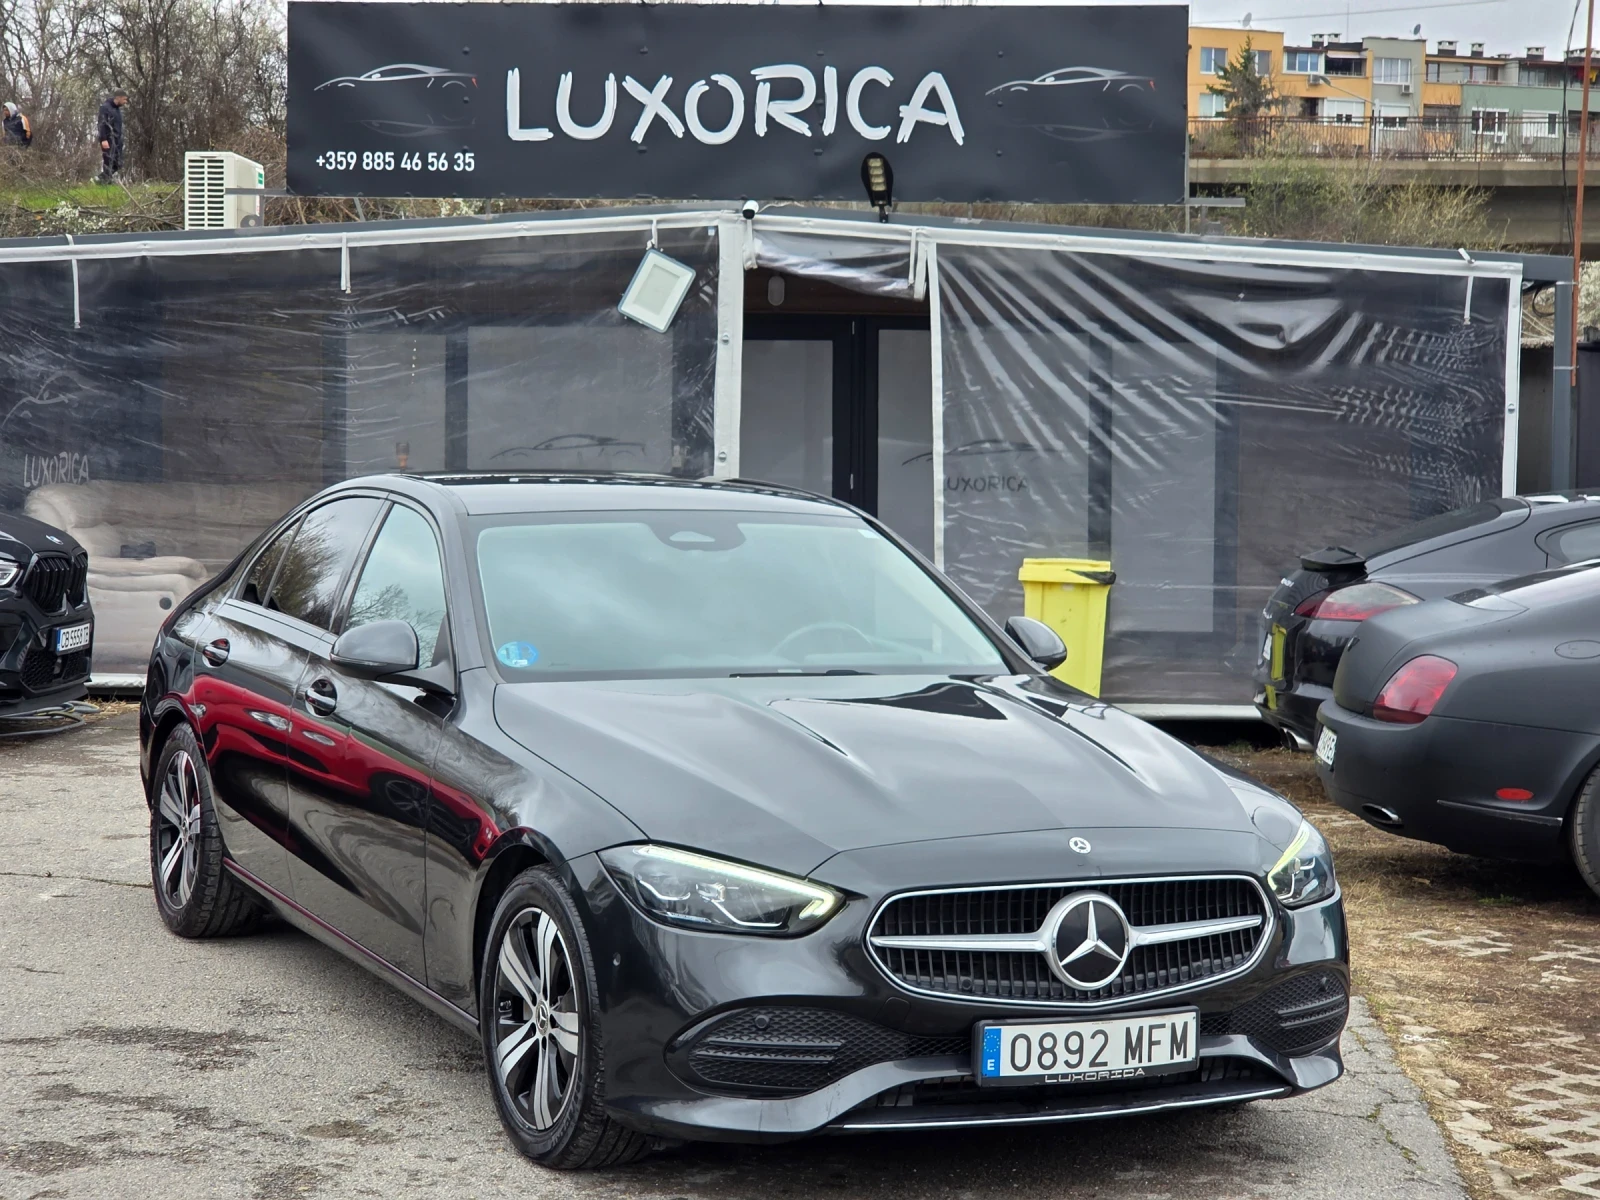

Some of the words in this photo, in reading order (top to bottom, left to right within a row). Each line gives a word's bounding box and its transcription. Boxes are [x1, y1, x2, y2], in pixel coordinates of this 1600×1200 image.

[506, 64, 965, 146] LUXORICA
[316, 151, 357, 171] +359
[362, 151, 395, 171] 885
[400, 152, 422, 171] 46
[427, 152, 449, 171] 56
[453, 152, 475, 172] 35
[23, 451, 89, 488] LUXORICA
[944, 475, 1029, 492] UXORICA
[1010, 1028, 1109, 1072] 0892
[1124, 1021, 1189, 1065] MFM
[986, 1059, 995, 1071] E
[1044, 1067, 1146, 1084] LUXORICA
